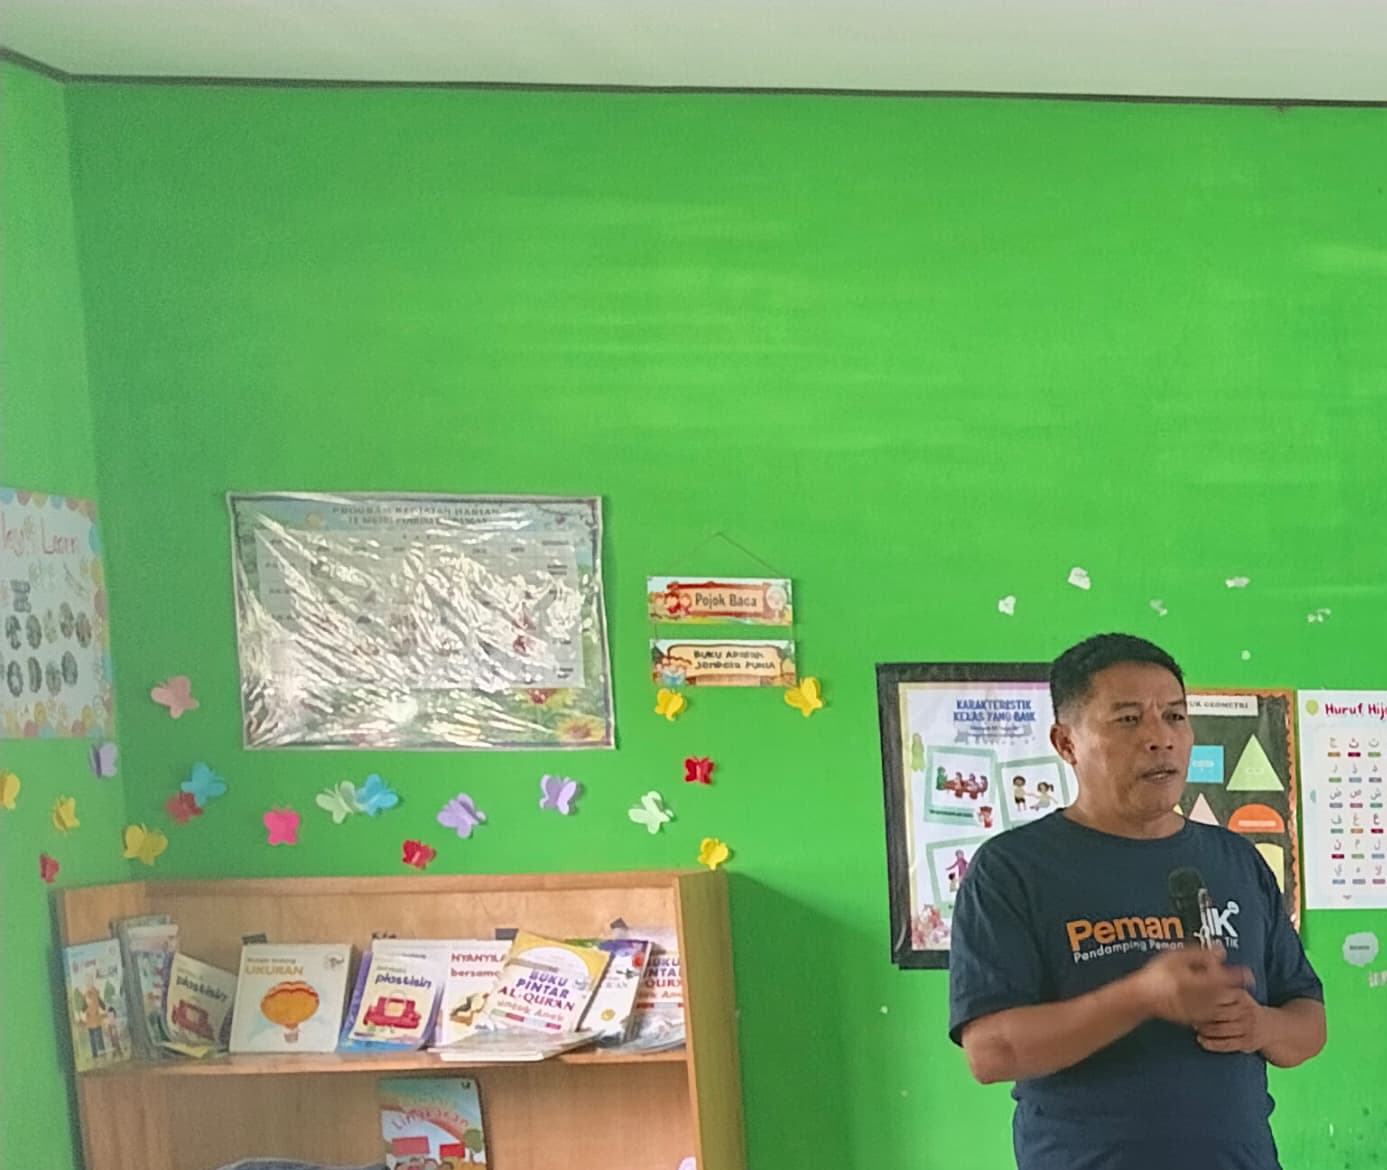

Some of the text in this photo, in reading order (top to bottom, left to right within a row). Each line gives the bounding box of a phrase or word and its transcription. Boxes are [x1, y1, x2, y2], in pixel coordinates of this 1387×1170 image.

[695, 592, 758, 610] Pojok Baca
[956, 699, 1031, 710] KARAKTERISTIK
[1325, 703, 1363, 716] Huruf
[953, 711, 1036, 721] KELAS YANG BAIK
[1073, 940, 1148, 963] Pendamping
[245, 965, 305, 975] UKURAN
[528, 969, 569, 988] BUKU
[176, 975, 229, 1001] plastisin
[375, 973, 432, 989] plastisin
[515, 978, 571, 1000] PINTAR
